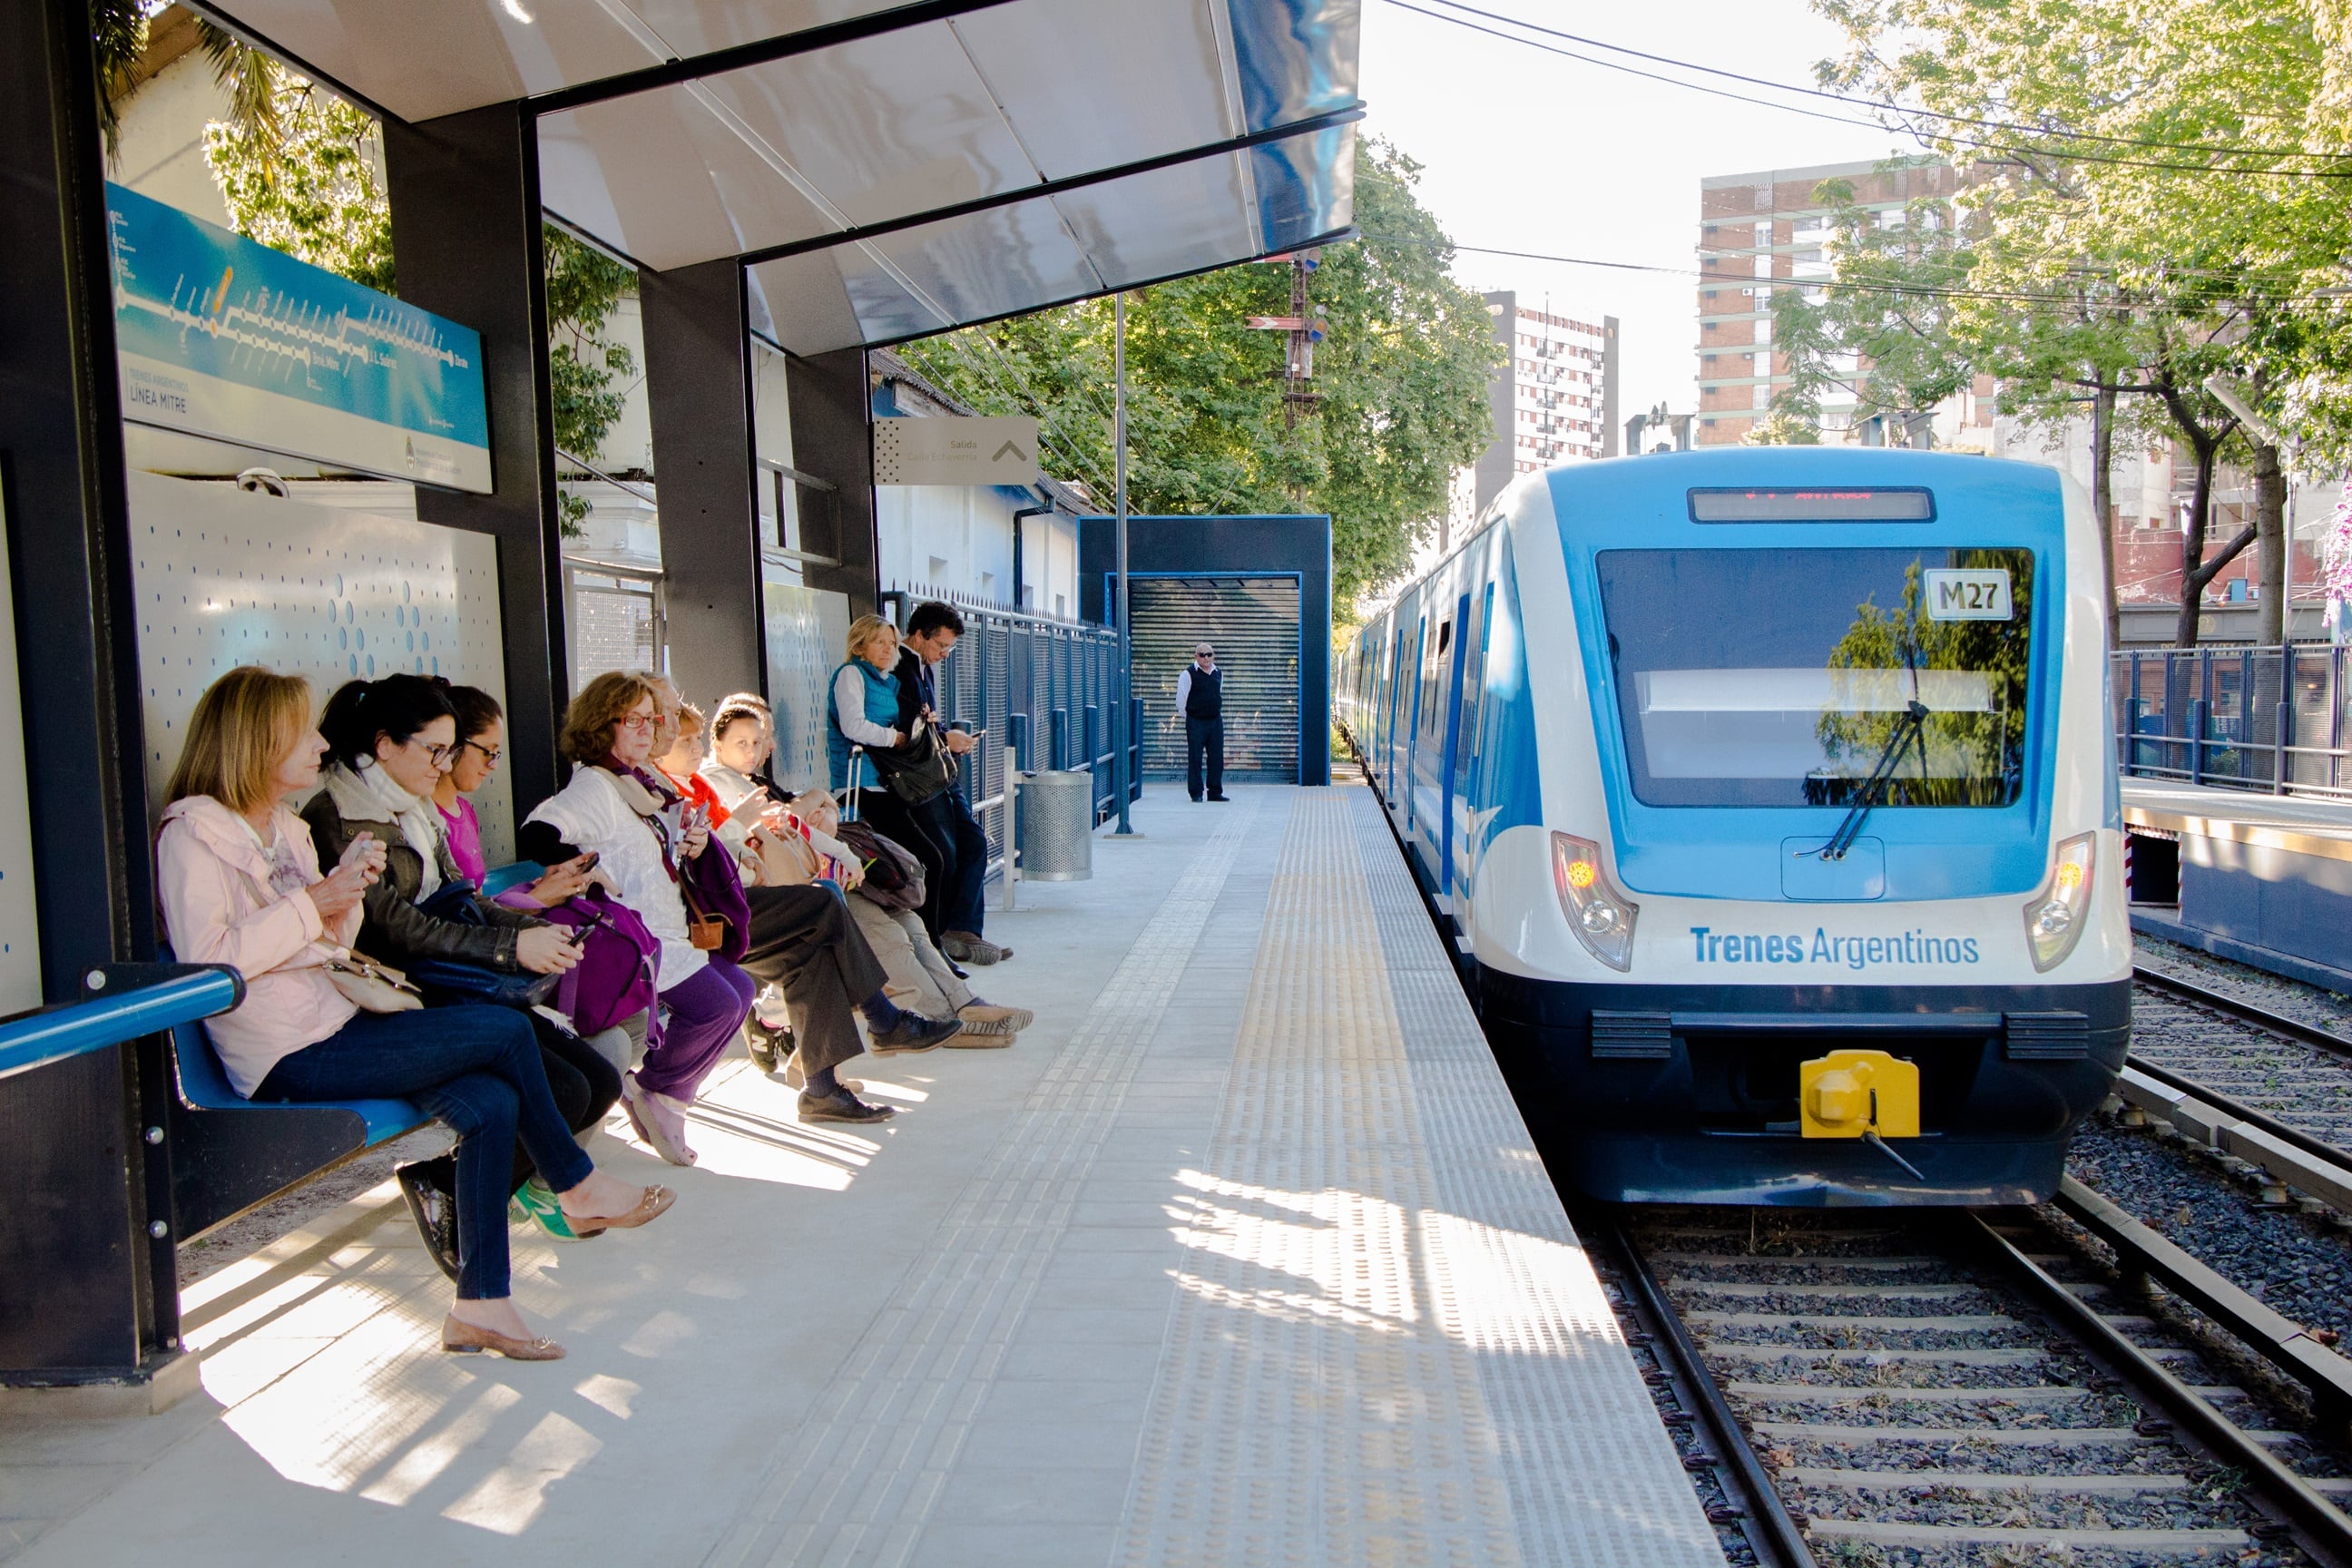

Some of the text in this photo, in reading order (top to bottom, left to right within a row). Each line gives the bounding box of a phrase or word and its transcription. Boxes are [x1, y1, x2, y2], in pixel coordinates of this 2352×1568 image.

[130, 382, 187, 414] LÍNEA MITRE
[950, 440, 978, 449] Salida
[1939, 581, 1998, 610] M27
[1690, 926, 1979, 970] Trenes Argentinos
